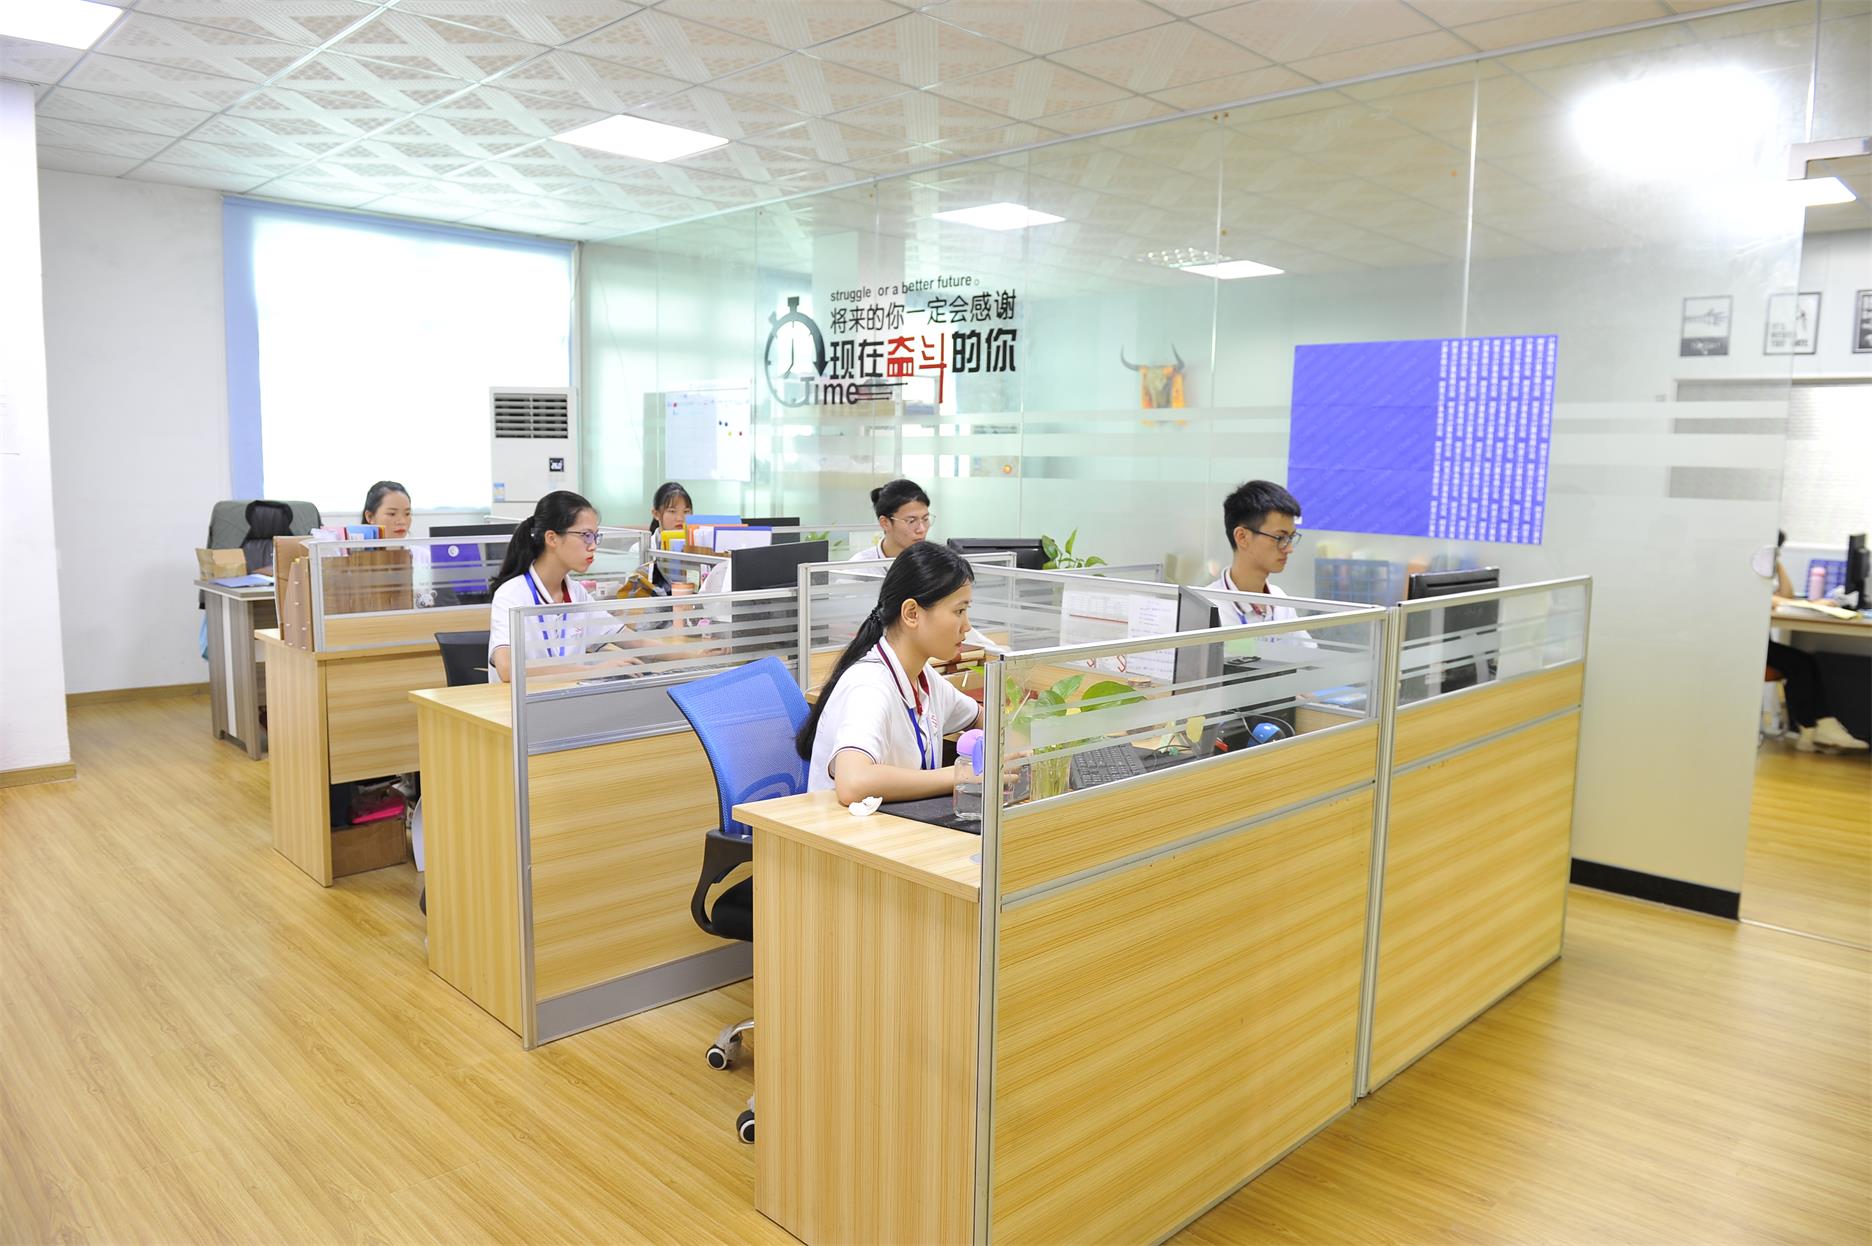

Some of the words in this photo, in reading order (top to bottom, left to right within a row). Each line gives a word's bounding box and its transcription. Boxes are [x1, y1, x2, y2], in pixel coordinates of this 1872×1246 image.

[830, 286, 872, 302] struggle
[877, 285, 890, 297] or
[892, 284, 899, 296] a
[901, 279, 934, 295] better
[830, 289, 1017, 335] 将来的你一定会感谢
